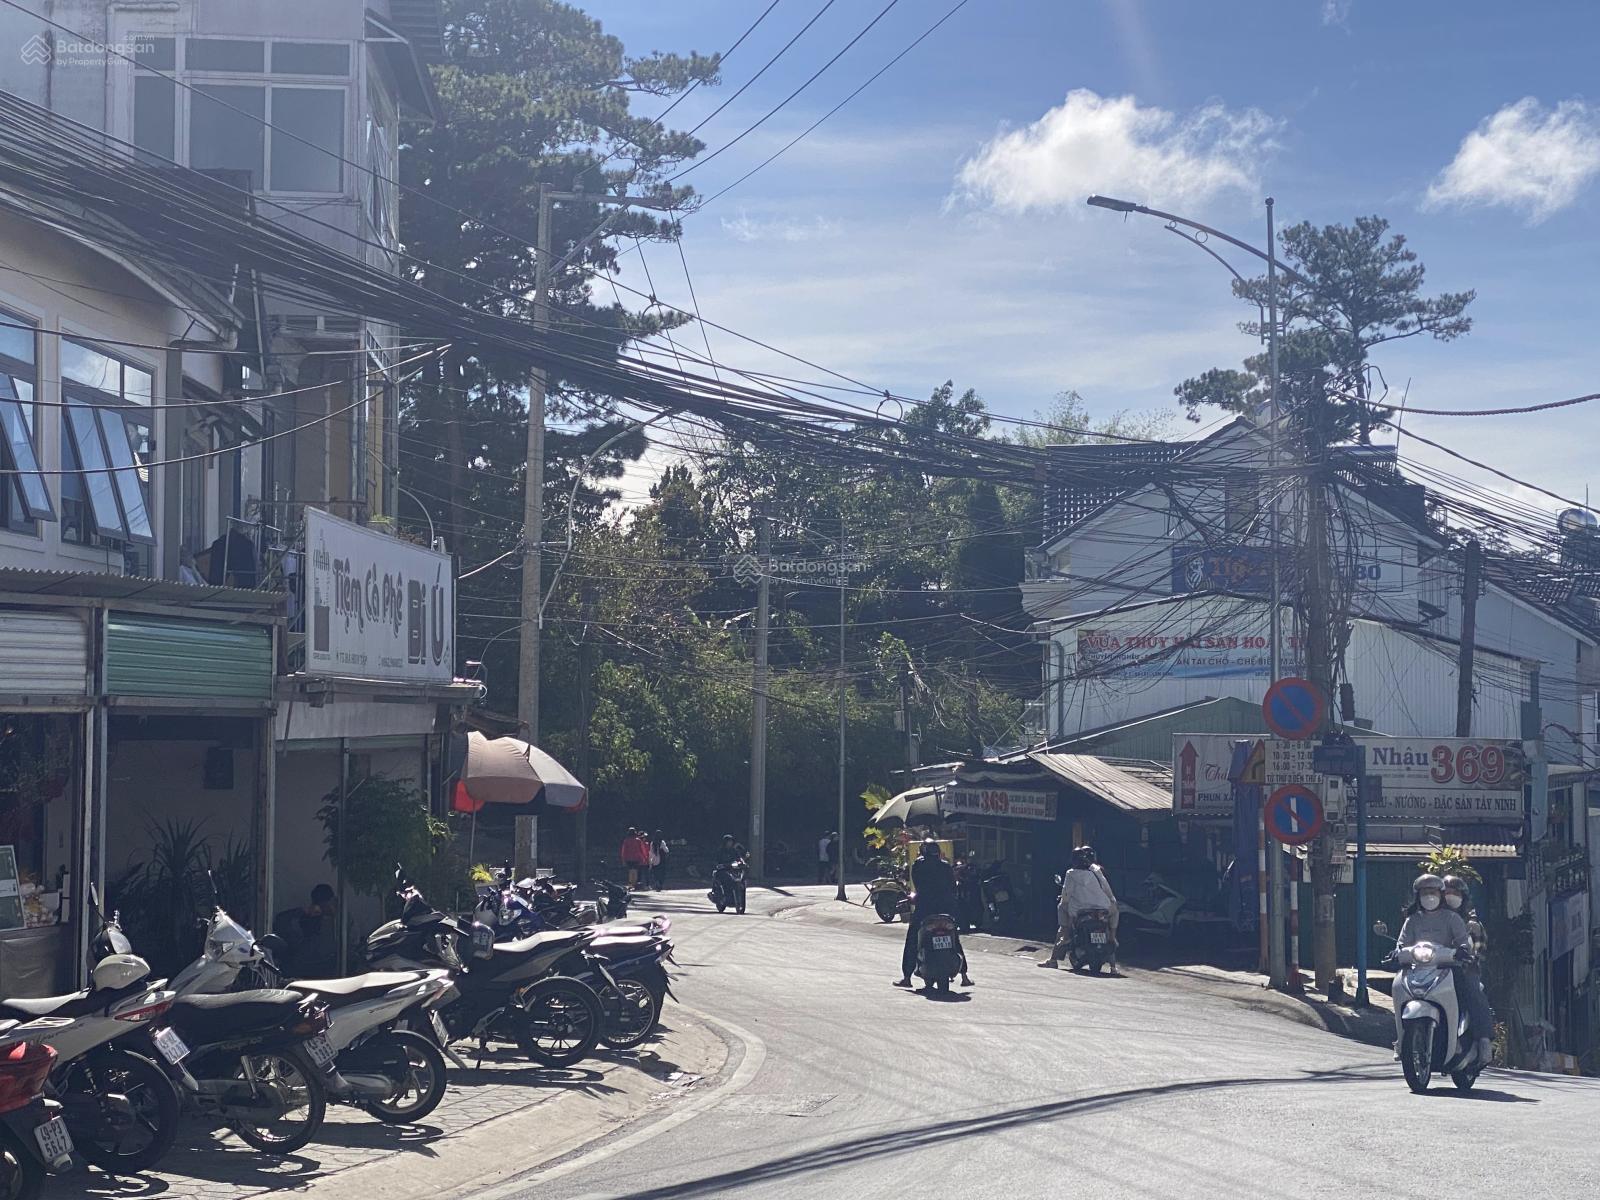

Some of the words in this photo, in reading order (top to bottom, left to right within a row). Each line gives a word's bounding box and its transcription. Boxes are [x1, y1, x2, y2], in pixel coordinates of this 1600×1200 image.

[332, 556, 364, 635] Tiệm
[1297, 751, 1313, 761] 12:0
[1372, 747, 1430, 771] Nhậu
[1430, 744, 1506, 784] 369
[980, 790, 1008, 812] 369
[1198, 792, 1221, 801] PHUN
[1494, 799, 1516, 811] NINH
[44, 1135, 68, 1158] 5647
